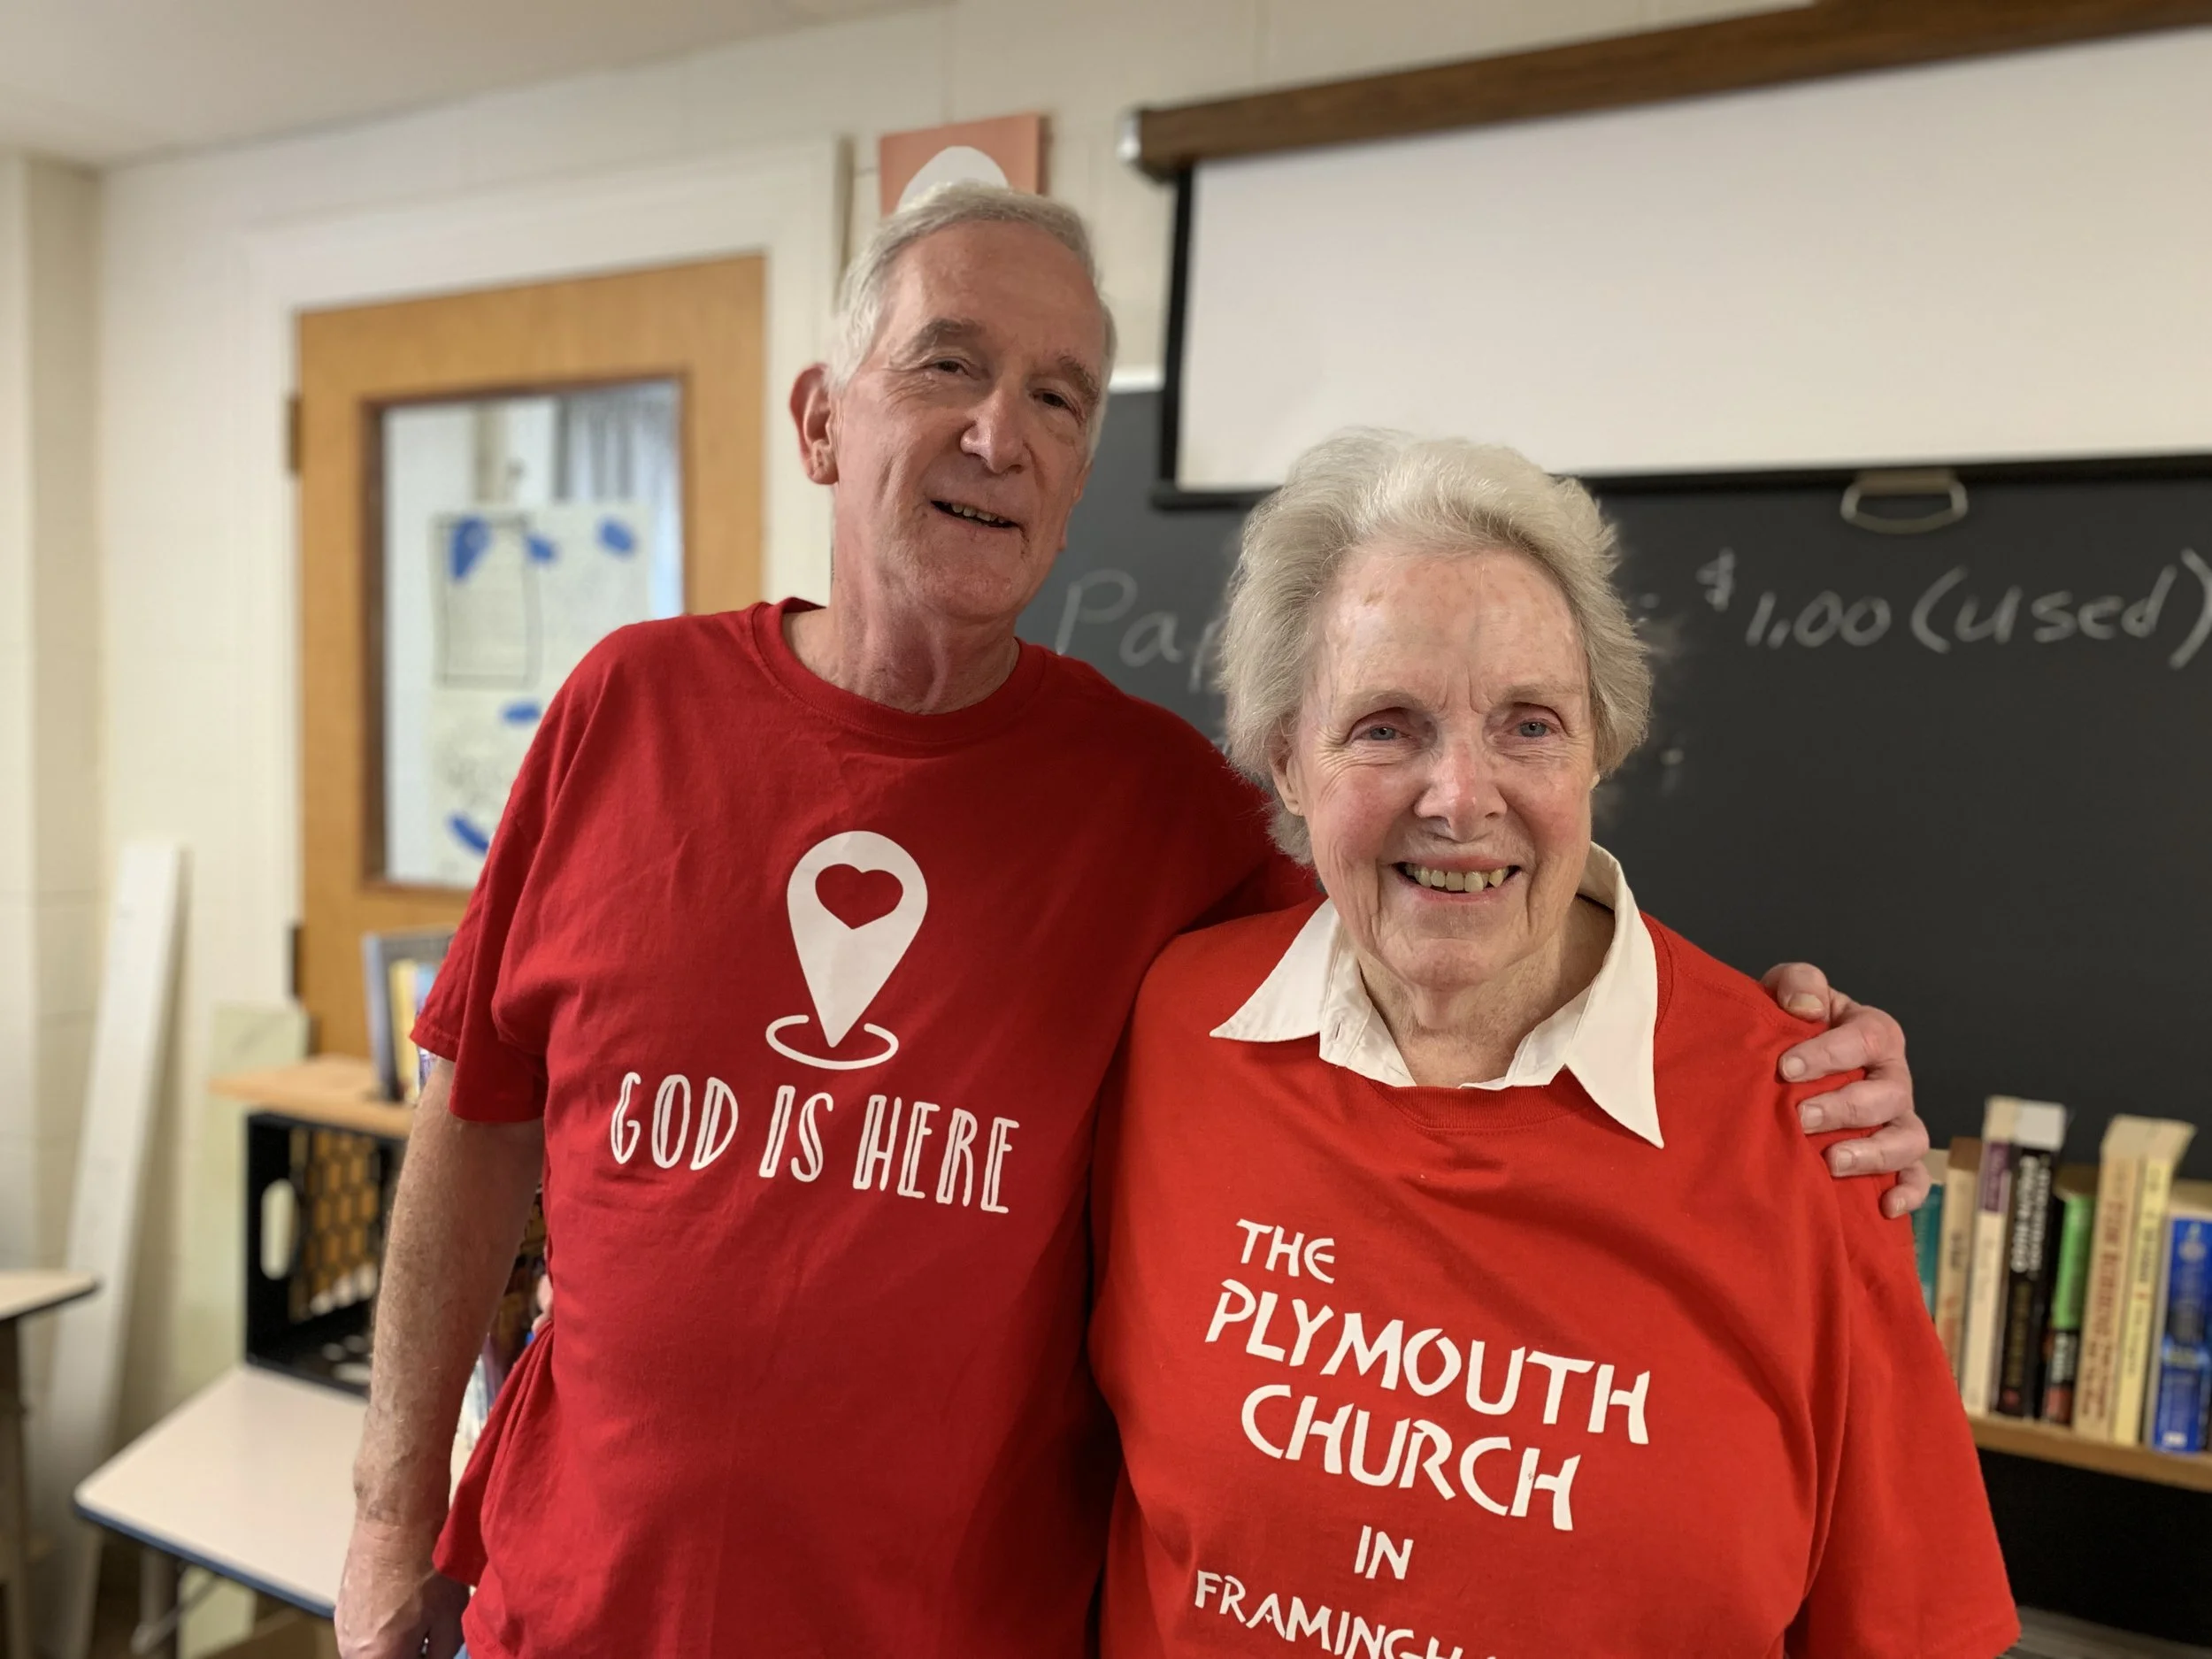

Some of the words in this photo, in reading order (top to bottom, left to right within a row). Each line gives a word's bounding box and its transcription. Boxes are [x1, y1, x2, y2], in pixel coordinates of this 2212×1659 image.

[1910, 547, 2212, 670] (used)
[610, 1071, 739, 1171] GOD
[758, 1085, 834, 1182] IS
[852, 1094, 1020, 1214] HERE
[1236, 1218, 1335, 1284] THE
[1204, 1279, 1650, 1445] PLYMOUTH
[1240, 1384, 1581, 1531] CHURCH
[1354, 1525, 1414, 1580] IN
[1194, 1570, 1497, 1659] FRAMINGH
